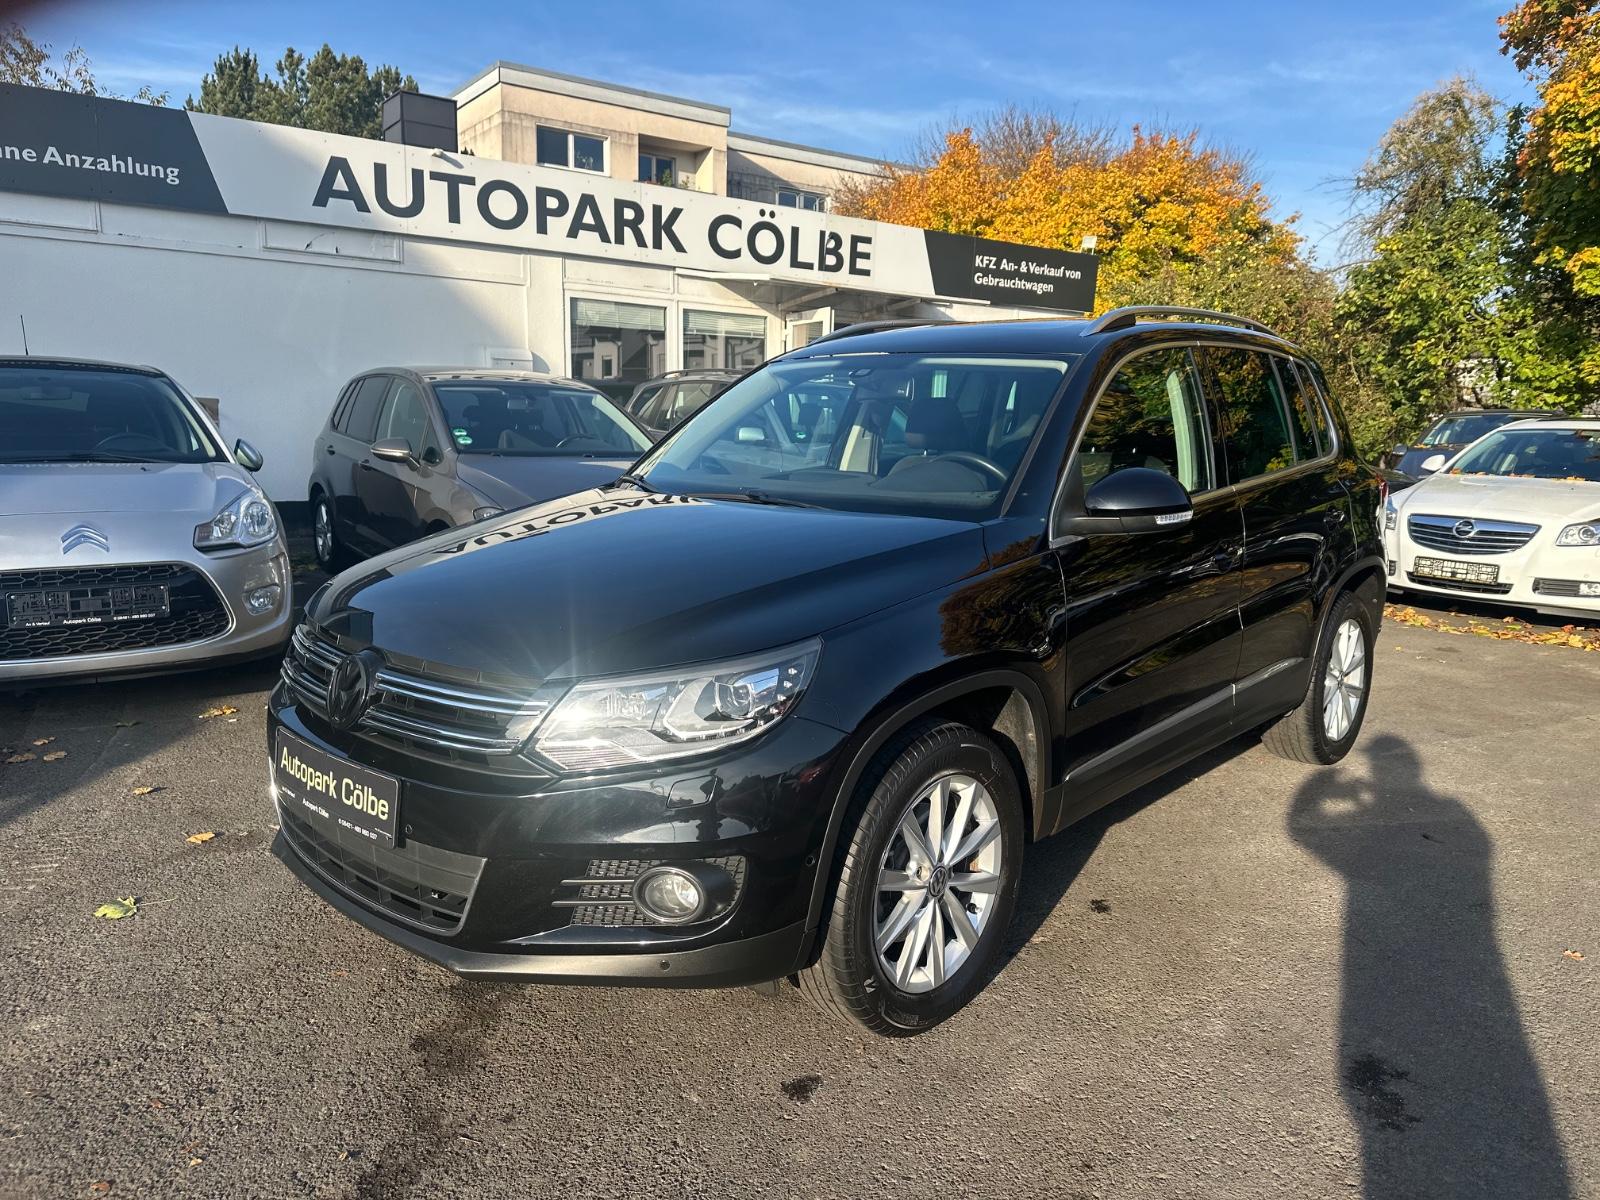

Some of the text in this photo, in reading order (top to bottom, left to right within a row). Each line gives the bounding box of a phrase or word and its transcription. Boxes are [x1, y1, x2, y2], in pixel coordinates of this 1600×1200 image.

[42, 146, 180, 185] Anzahlung
[312, 155, 872, 277] AUTOPARK CÖLBE
[974, 272, 1054, 294] Gebrauchtwagen
[975, 255, 1082, 280] KFZ An- & Verkauf von
[280, 746, 389, 821] Autopark Cölbe
